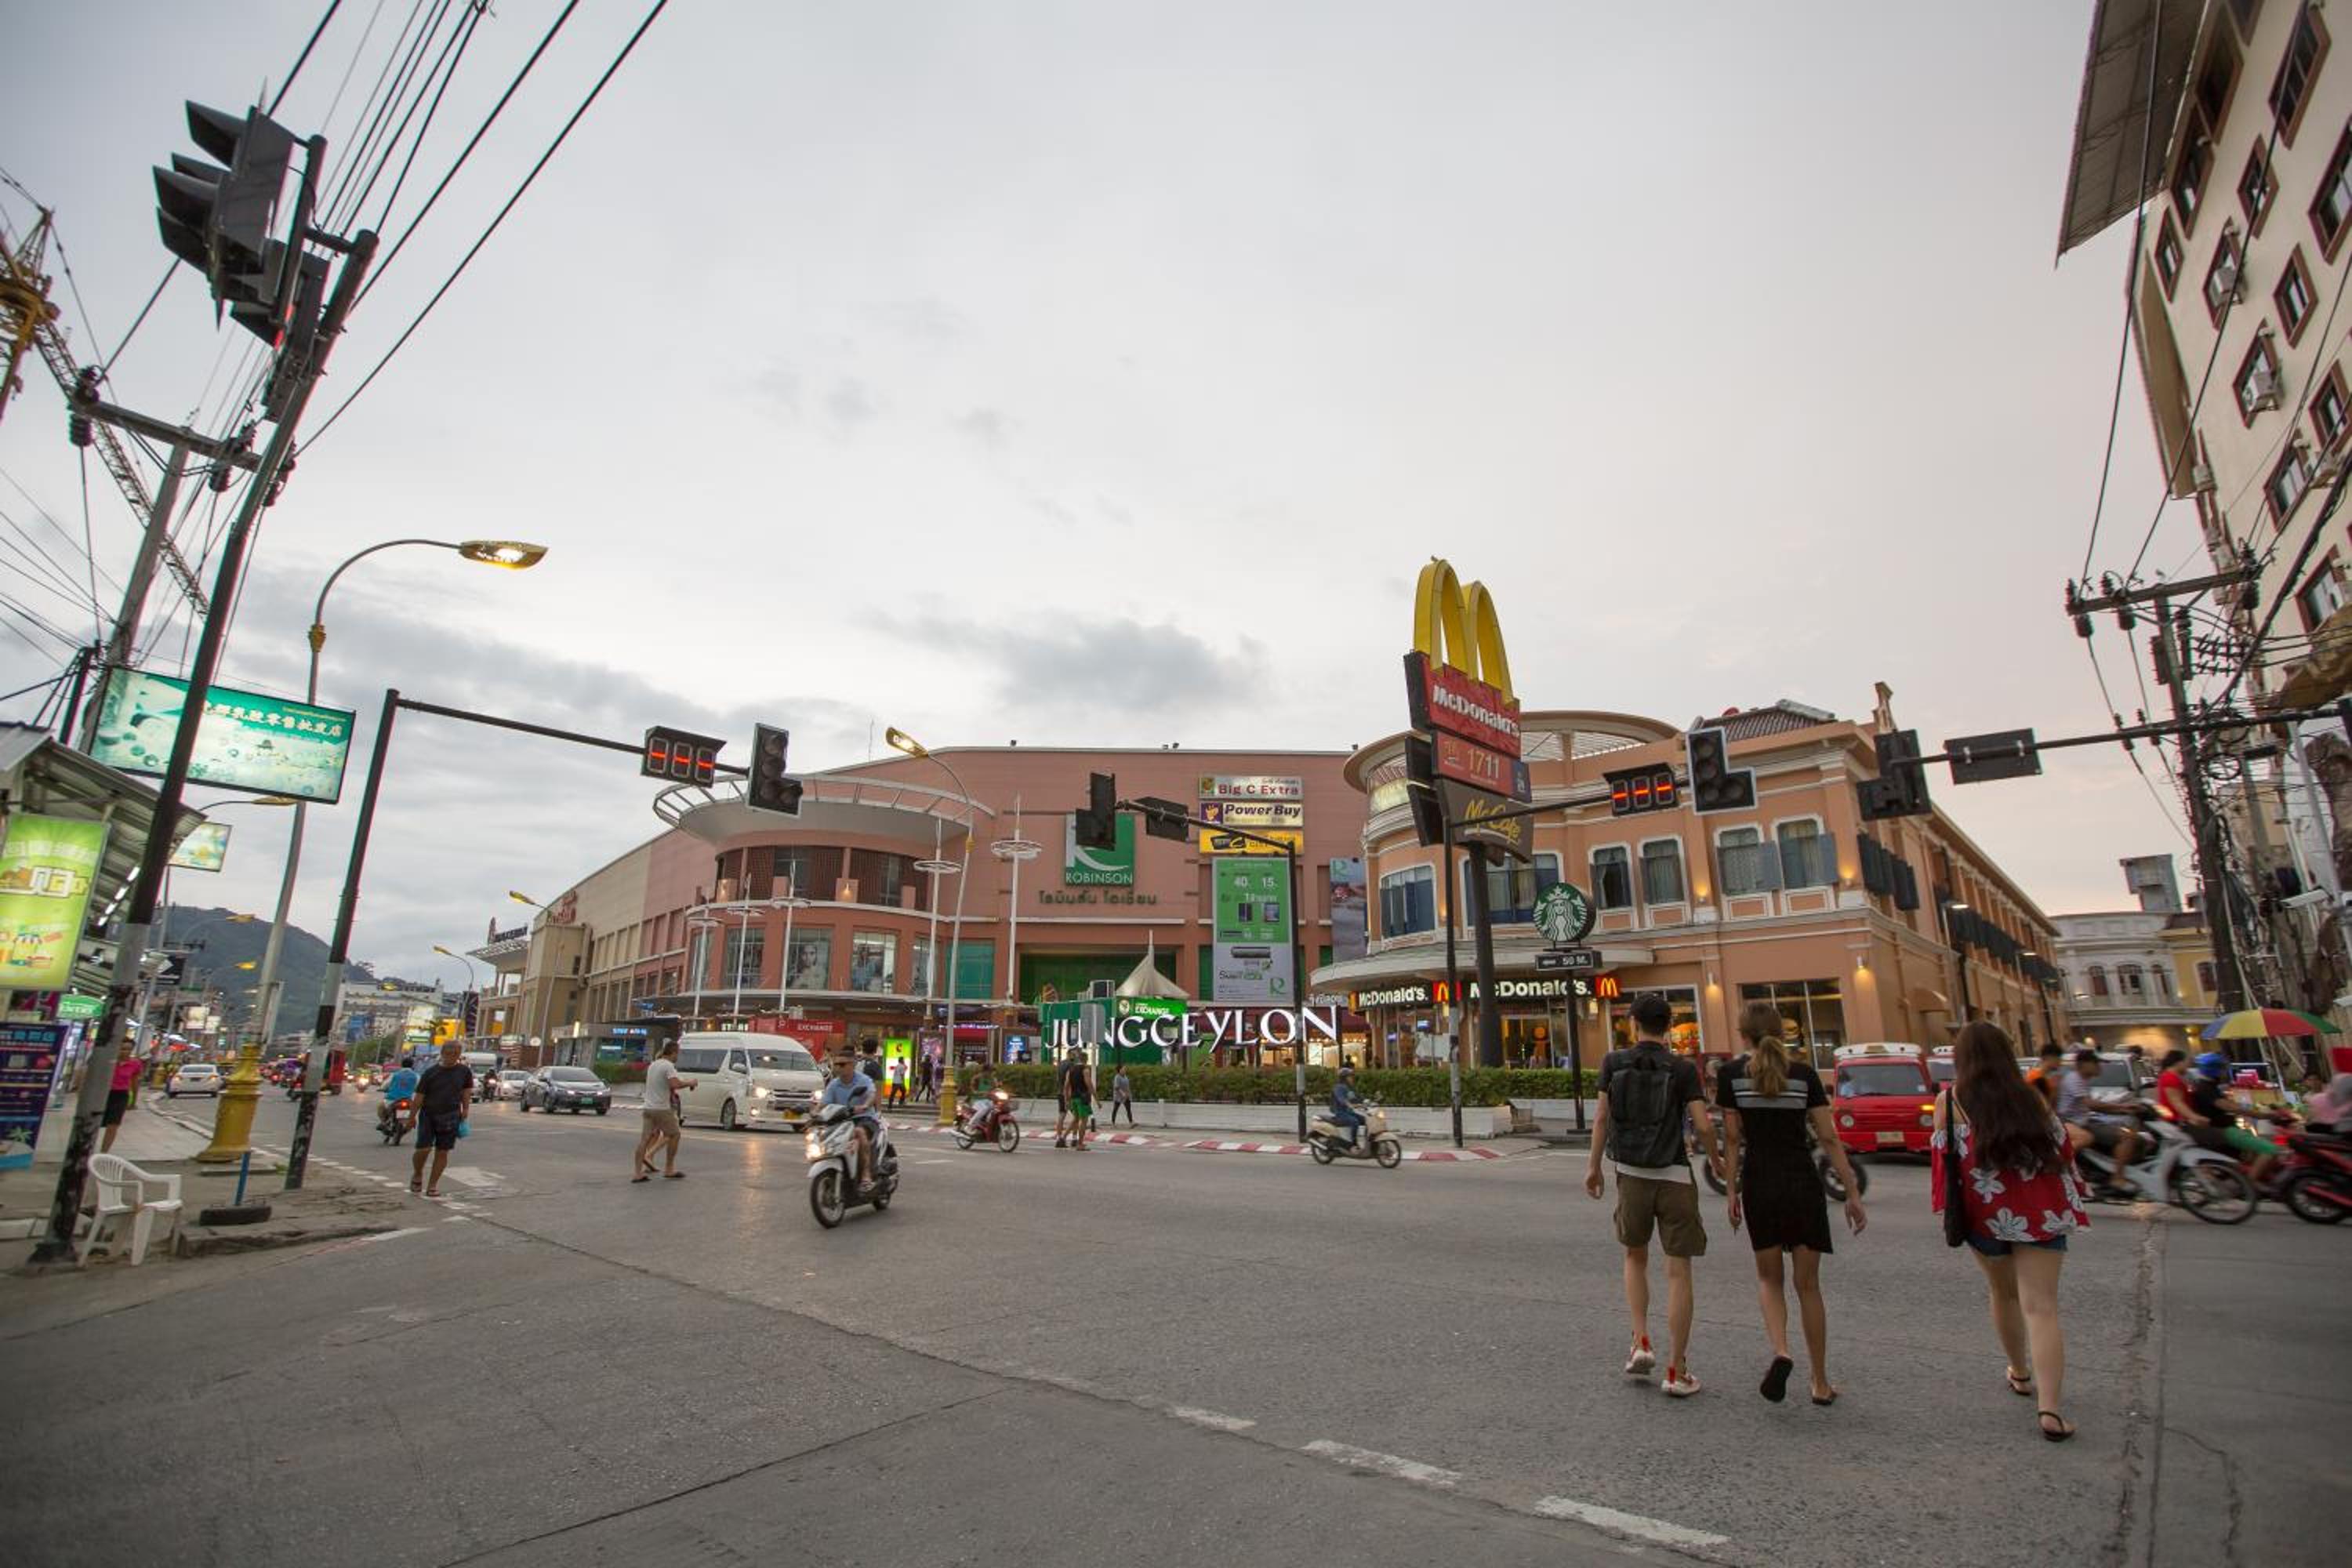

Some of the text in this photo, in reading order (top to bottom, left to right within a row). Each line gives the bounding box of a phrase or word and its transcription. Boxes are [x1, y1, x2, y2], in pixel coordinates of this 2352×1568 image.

[1432, 684, 1519, 737] McDonald's
[1467, 748, 1500, 779] 1711
[1218, 785, 1299, 795] Big C Extra
[1065, 873, 1133, 884] ROBINSON
[1135, 1005, 1170, 1015] EXCHANGE
